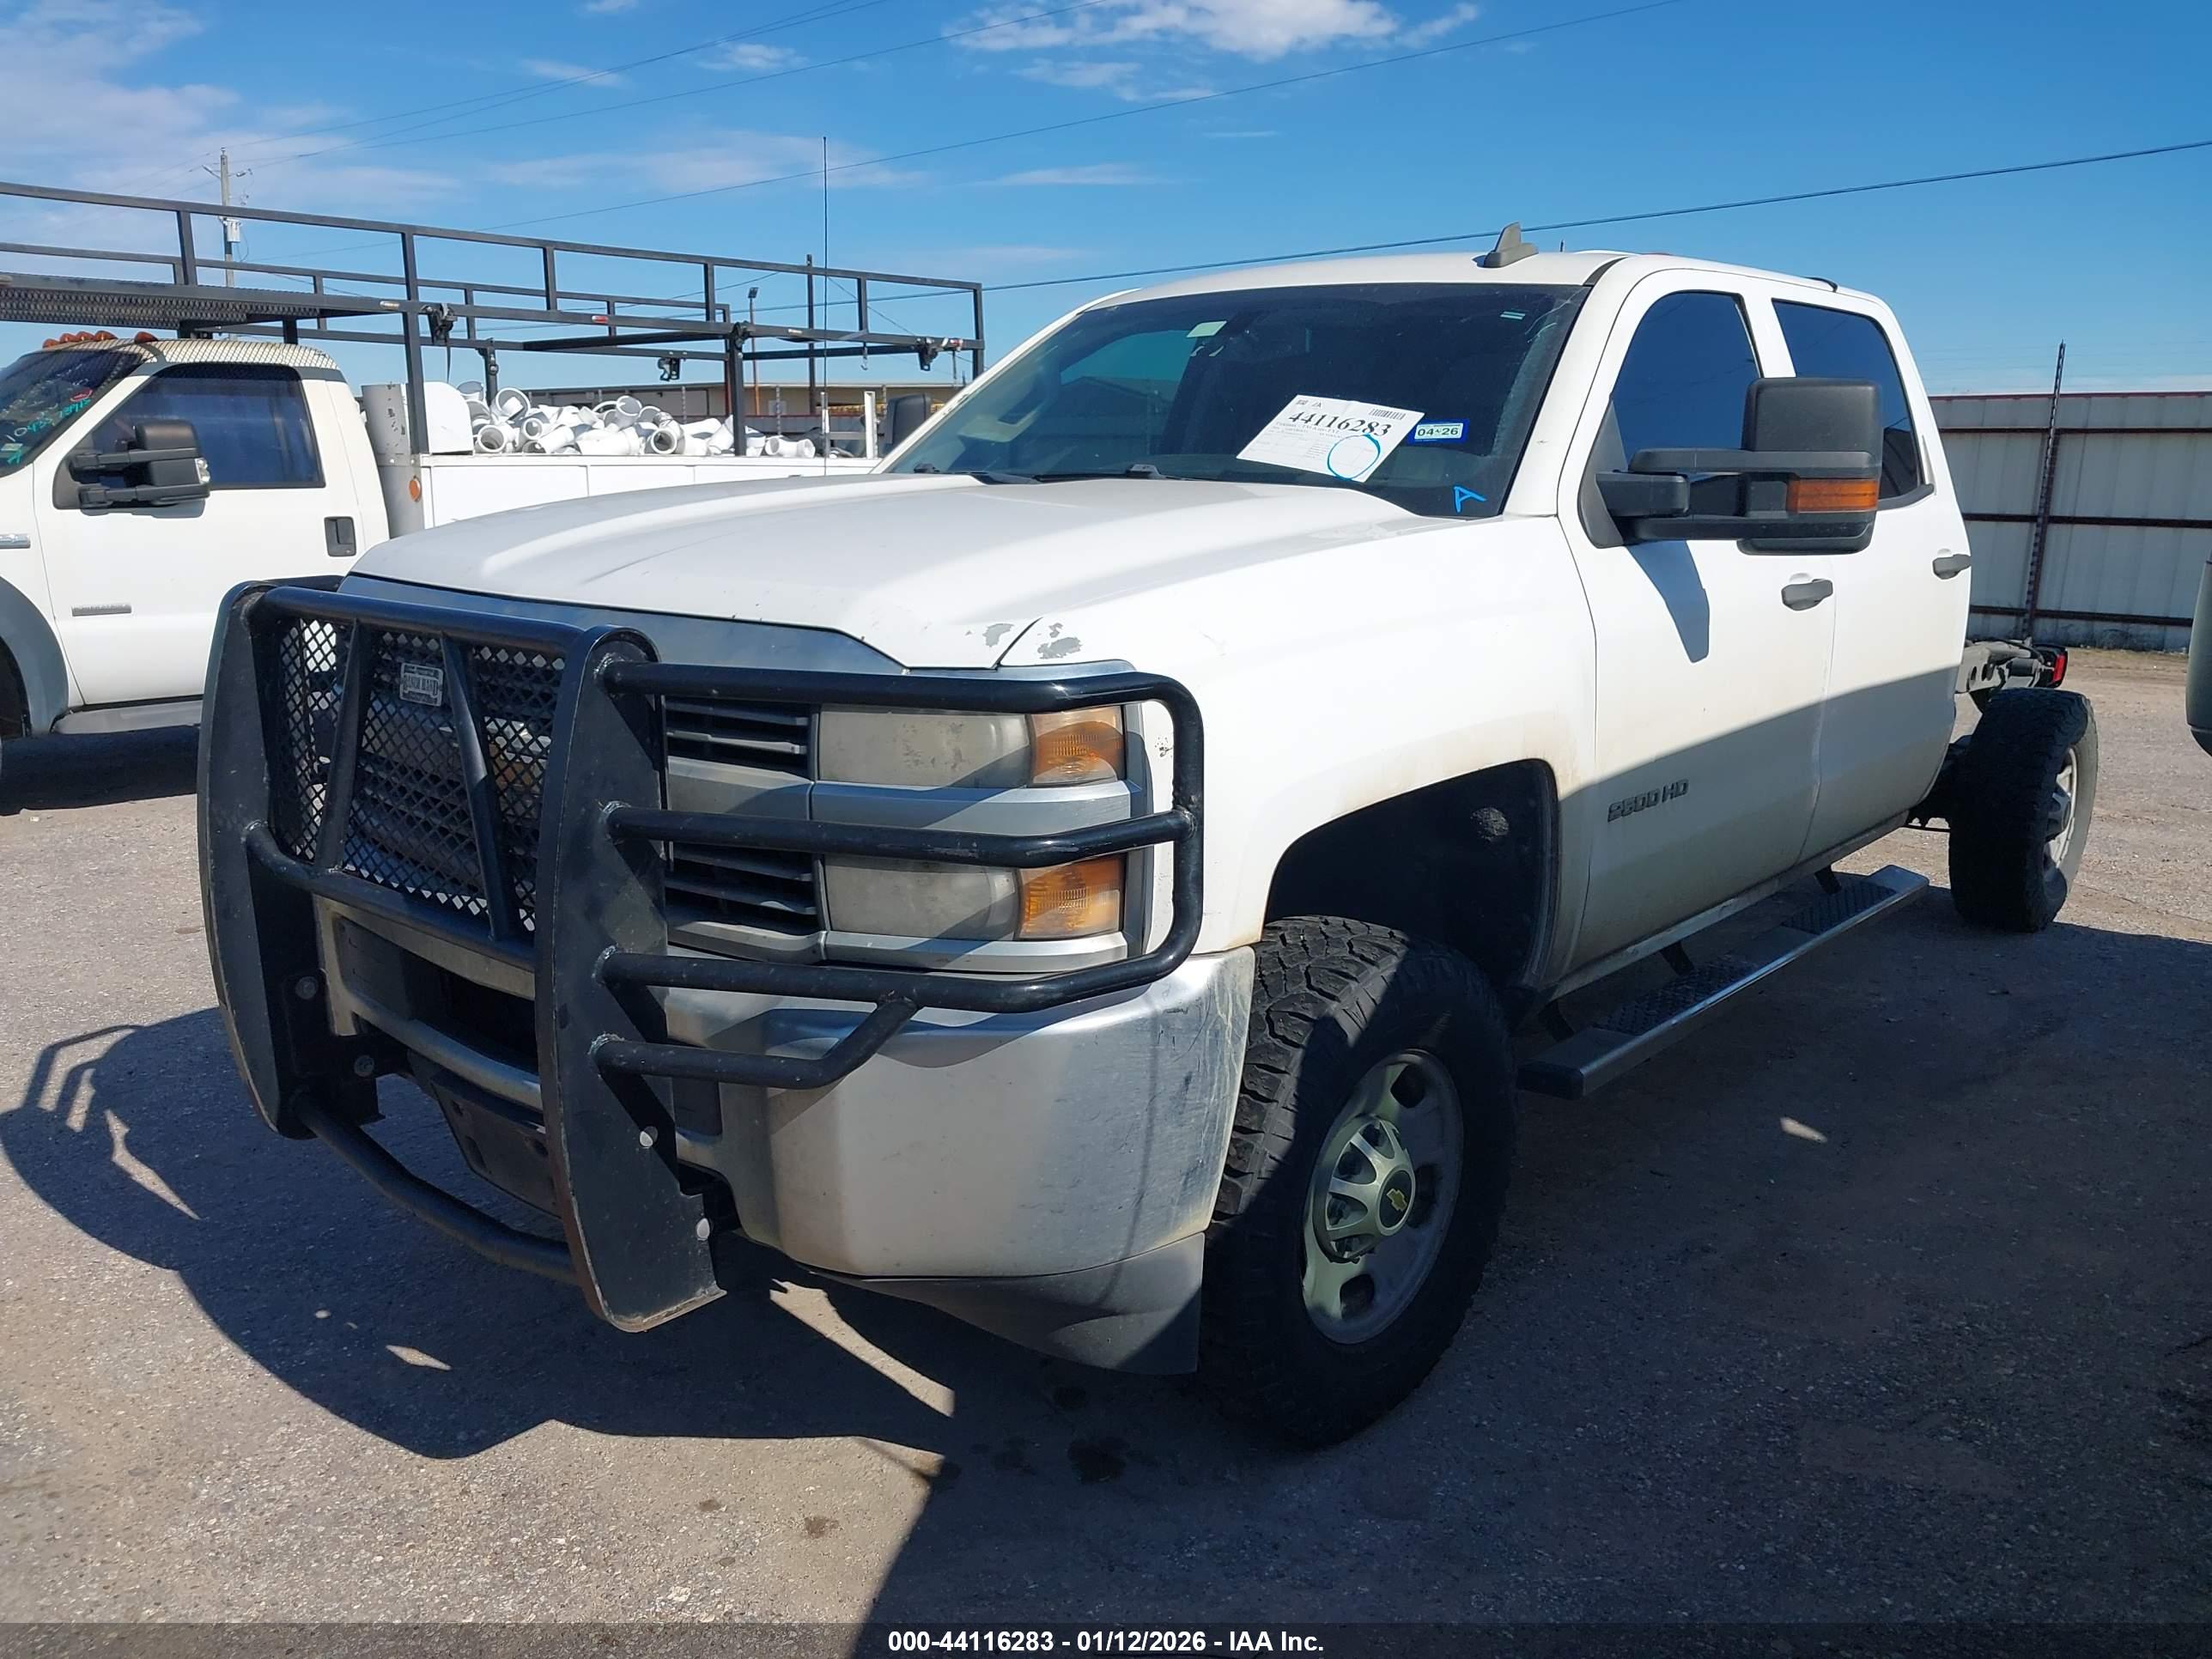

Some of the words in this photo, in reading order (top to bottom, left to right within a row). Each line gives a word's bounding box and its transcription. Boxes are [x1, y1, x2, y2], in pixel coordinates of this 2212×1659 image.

[1288, 411, 1391, 436] 44116283
[1417, 428, 1434, 436] 04
[1441, 427, 1459, 435] 26
[1662, 778, 1688, 803] HD
